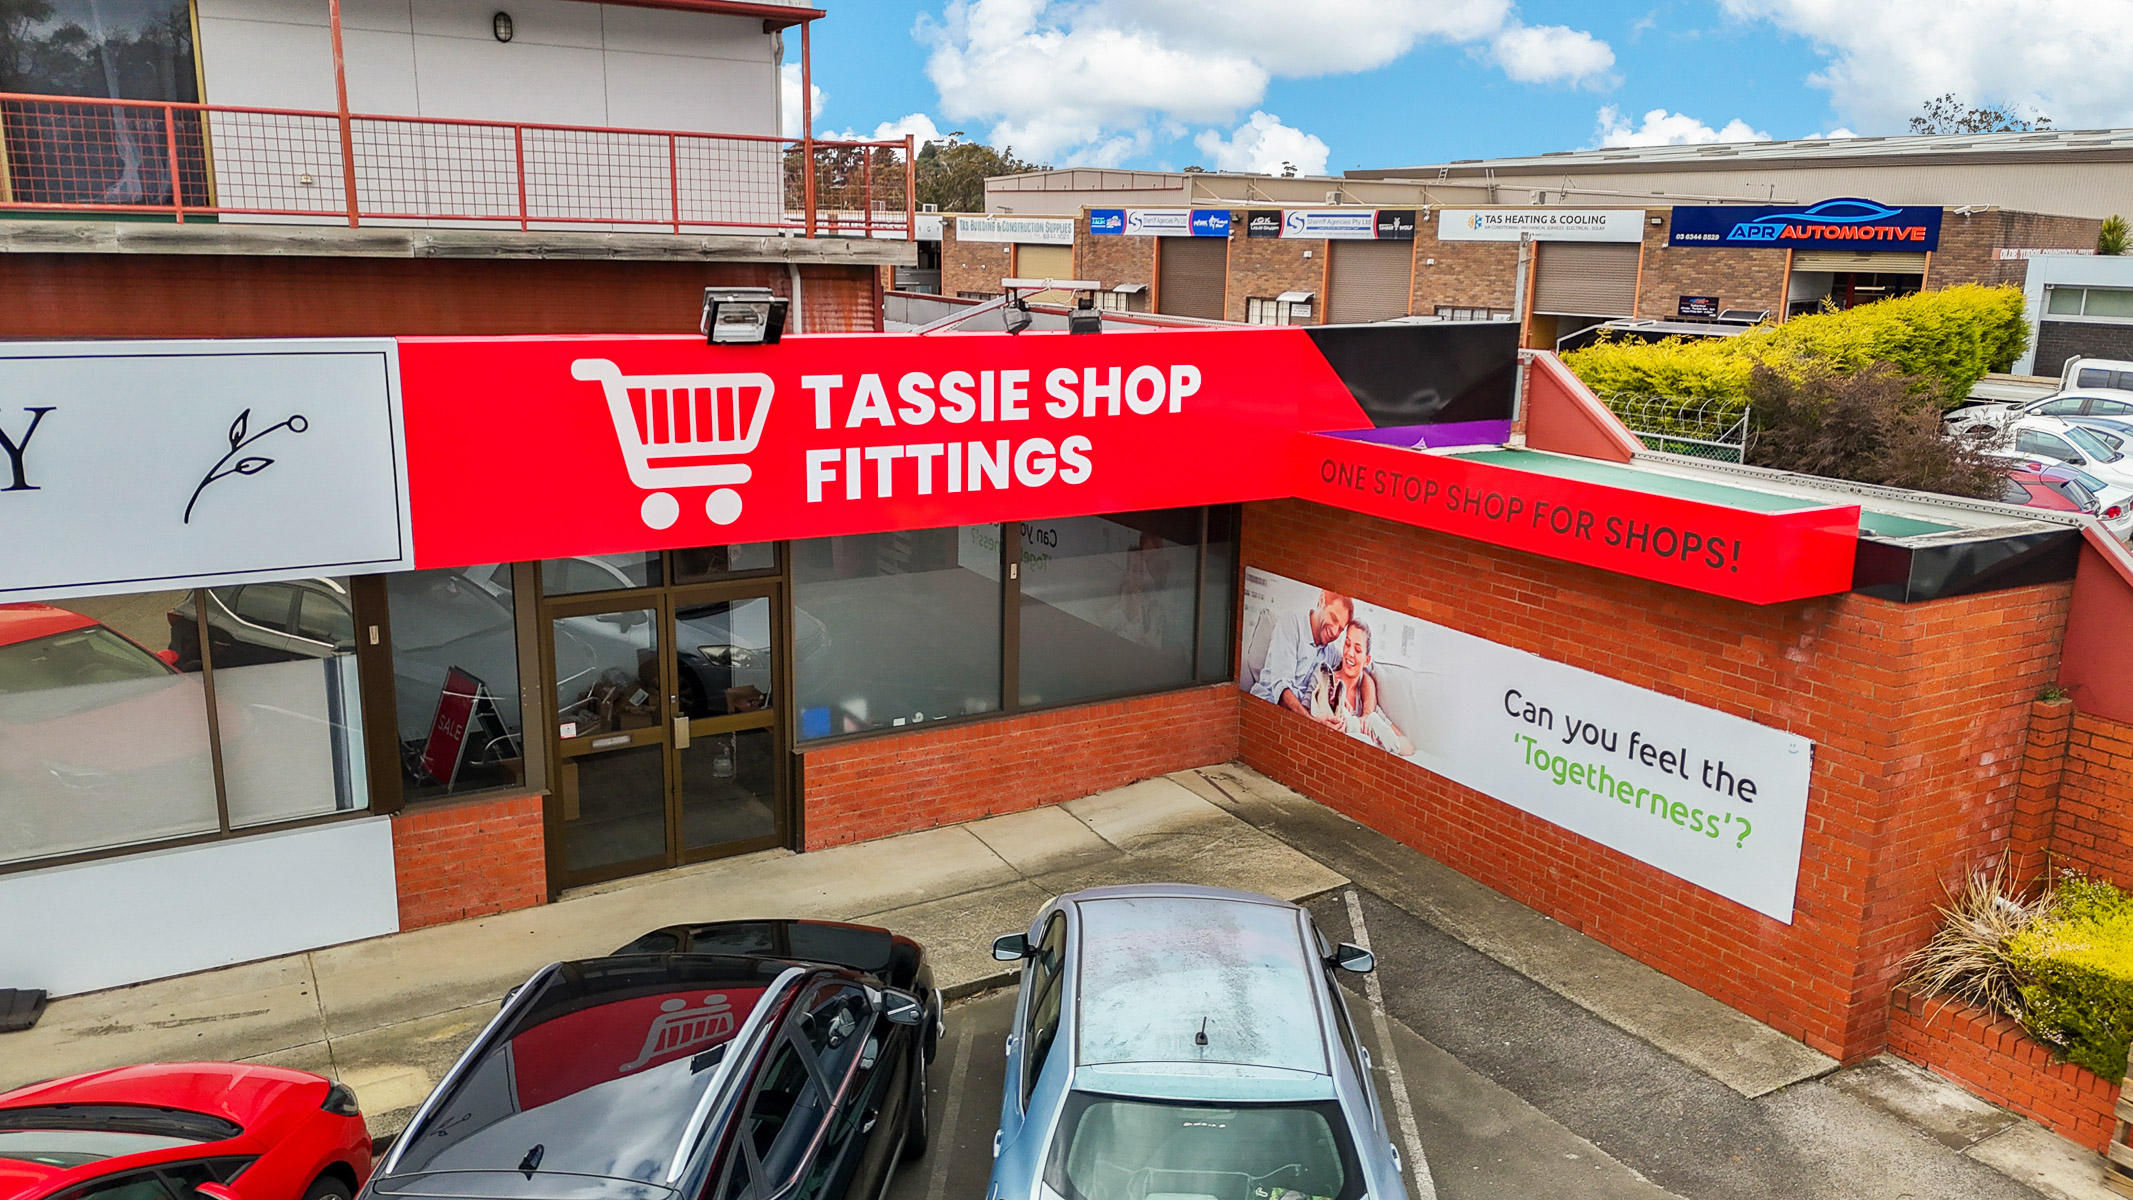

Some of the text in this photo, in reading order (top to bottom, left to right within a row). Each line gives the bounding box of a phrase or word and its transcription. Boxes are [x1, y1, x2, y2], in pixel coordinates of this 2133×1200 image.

[970, 220, 995, 232] BUILDING
[1002, 221, 1044, 233] CONSTRUCTION
[1045, 221, 1072, 234] SUPPLIES
[1352, 218, 1361, 226] Pty
[1485, 215, 1607, 225] TAS HEATING & COOLING
[1732, 225, 1926, 241] APR AUTOMOTIVE
[801, 364, 1202, 430] TASSIE SHOP
[806, 434, 1093, 503] FITTINGS
[1320, 458, 1742, 574] ONE STOP SHOP FOR SHOPS!
[438, 713, 463, 742] SALE
[1504, 690, 1758, 804] Can you feel the
